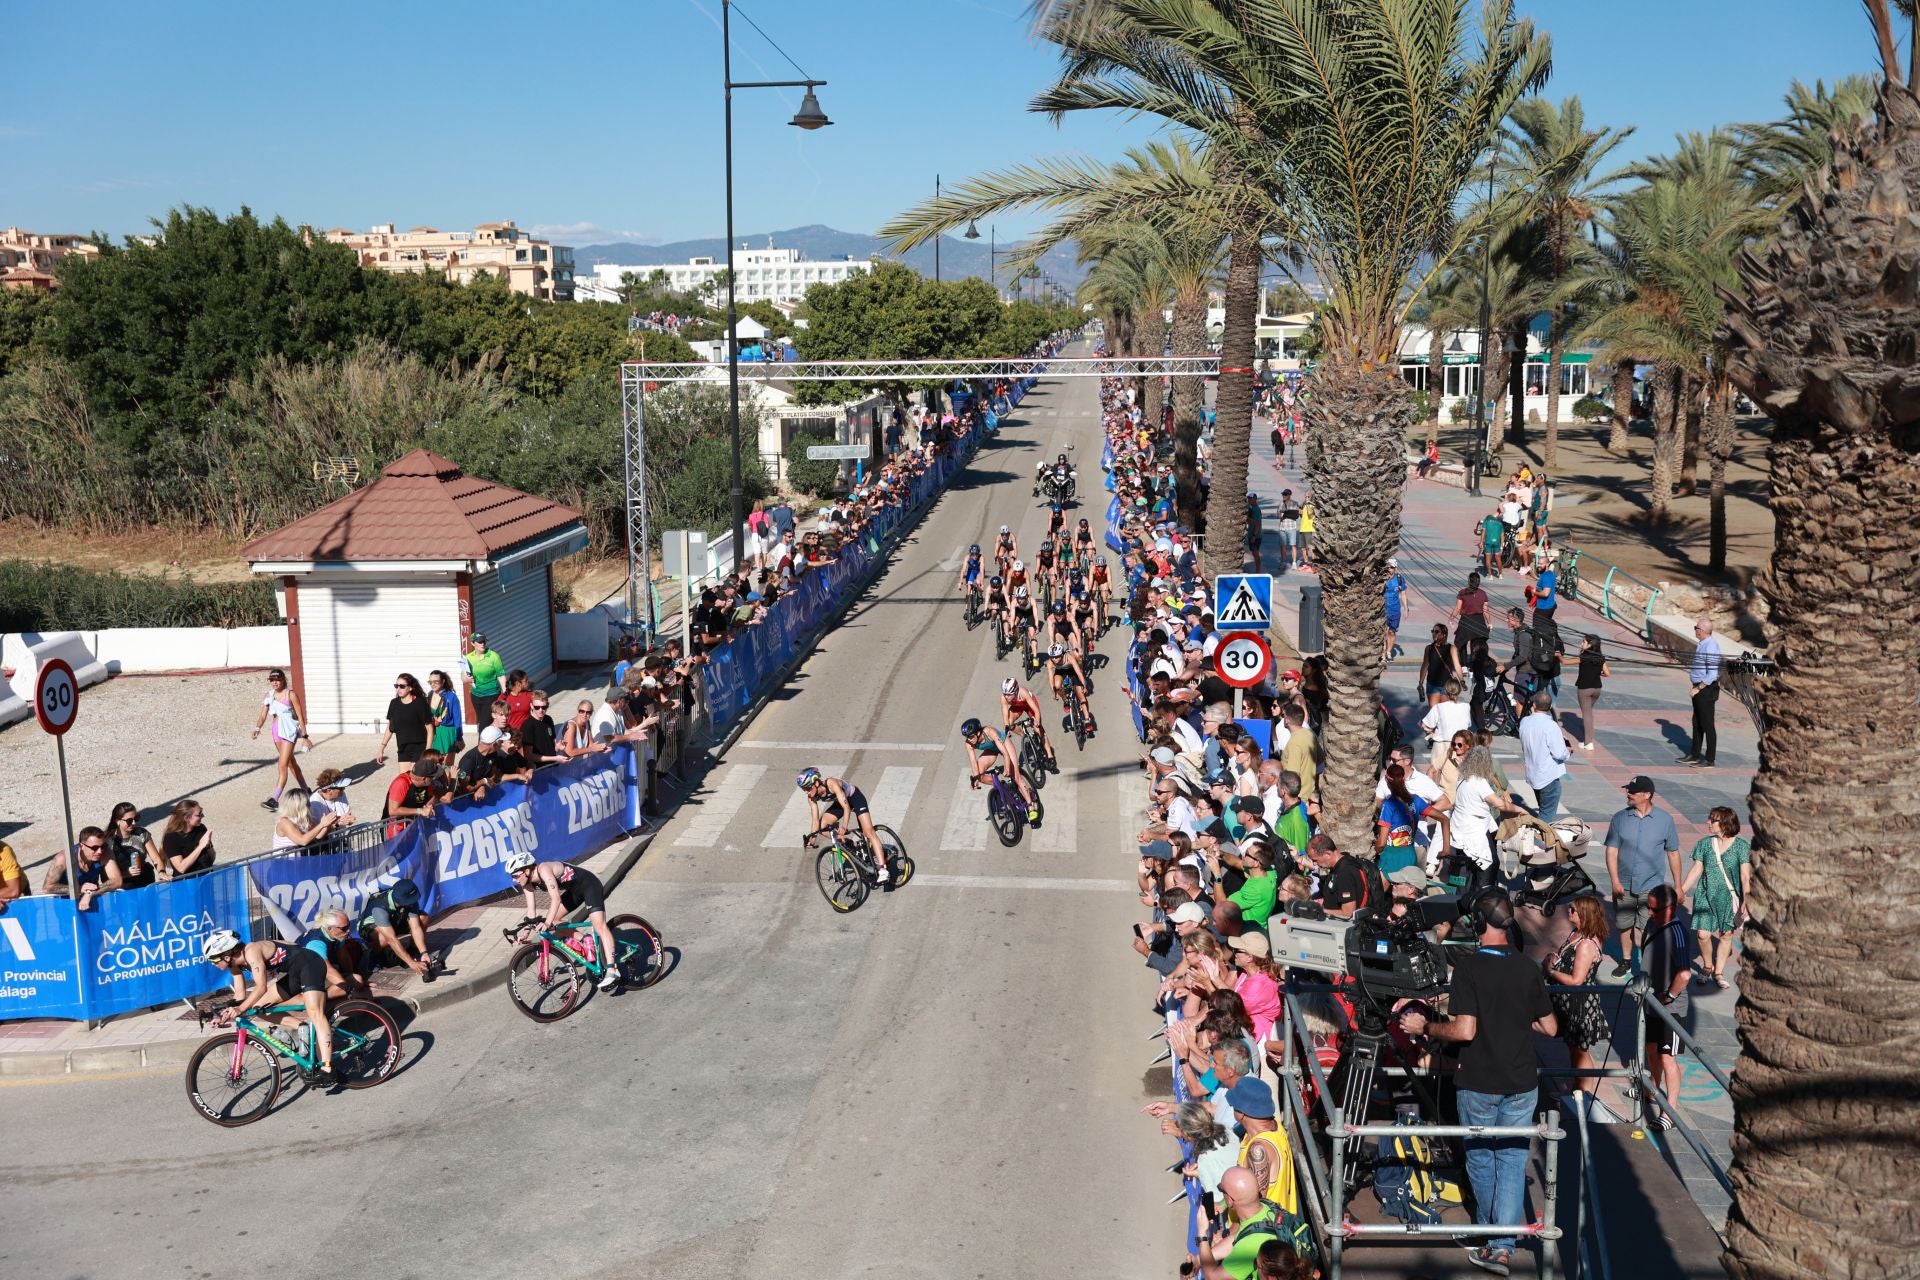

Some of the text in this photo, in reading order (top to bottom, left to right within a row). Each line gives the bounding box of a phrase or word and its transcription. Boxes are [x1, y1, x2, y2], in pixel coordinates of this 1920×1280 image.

[1226, 650, 1258, 669] 30
[46, 682, 71, 711] 30
[558, 767, 627, 835] 226ERS
[431, 801, 538, 883] 226ERS
[102, 910, 215, 949] MÁLAGA
[4, 969, 67, 982] Provincial
[98, 975, 112, 985] LA
[114, 962, 173, 981] PROVINCIA
[175, 958, 190, 969] EN
[0, 986, 36, 999] álaga
[249, 1040, 276, 1067] roval
[380, 1045, 398, 1077] roval
[192, 1092, 222, 1120] roval
